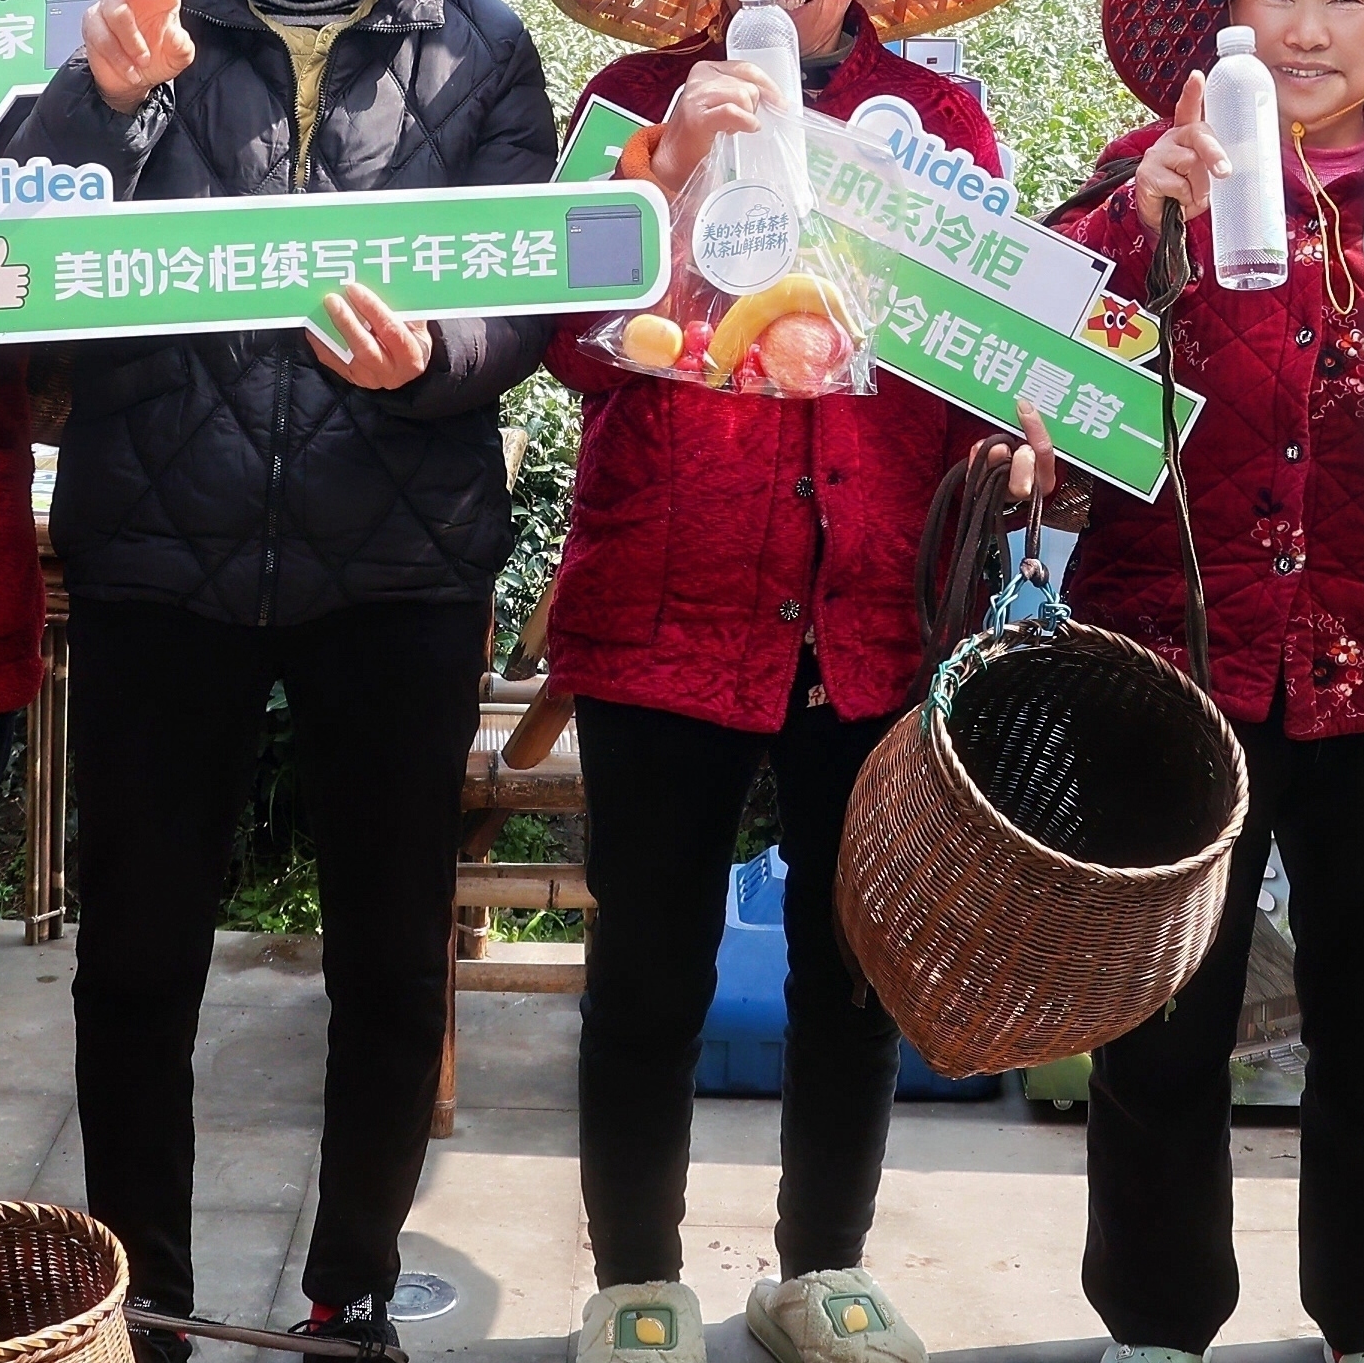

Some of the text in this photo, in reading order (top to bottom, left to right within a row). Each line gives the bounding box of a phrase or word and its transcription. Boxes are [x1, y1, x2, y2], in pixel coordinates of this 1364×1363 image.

[855, 102, 1012, 218] Midea
[700, 231, 790, 261] 从茶山鲜到茶杯
[702, 211, 790, 242] 美的冷柜春茶季
[53, 229, 559, 302] 美的冷柜续写千年茶经
[868, 273, 1164, 450] 冷柜销量第一
